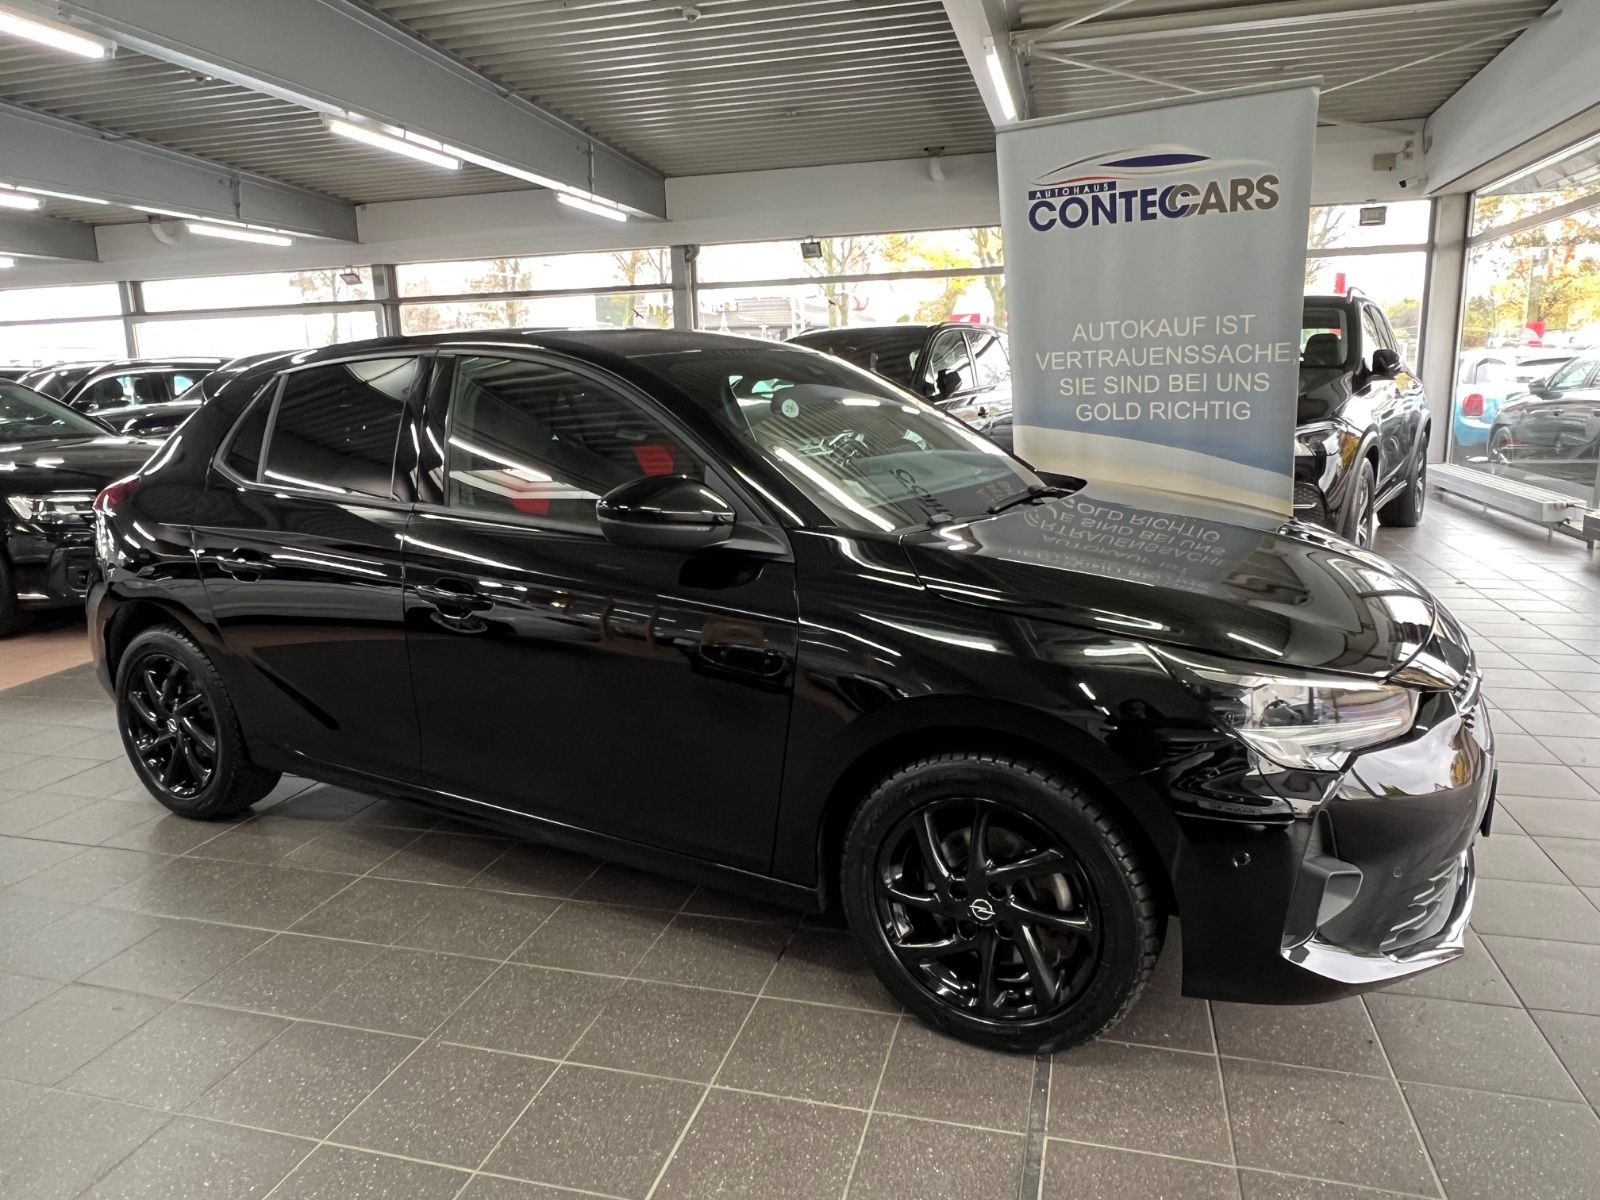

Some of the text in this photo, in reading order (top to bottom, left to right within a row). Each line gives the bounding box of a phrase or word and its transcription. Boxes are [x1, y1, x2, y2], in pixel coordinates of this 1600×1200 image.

[1034, 182, 1110, 199] AUTOHAUS
[1071, 314, 1256, 342] AUTOKAUF IST
[1059, 372, 1270, 396] SIE SIND BEI UNS
[1075, 400, 1251, 422] GOLD RICHTIG
